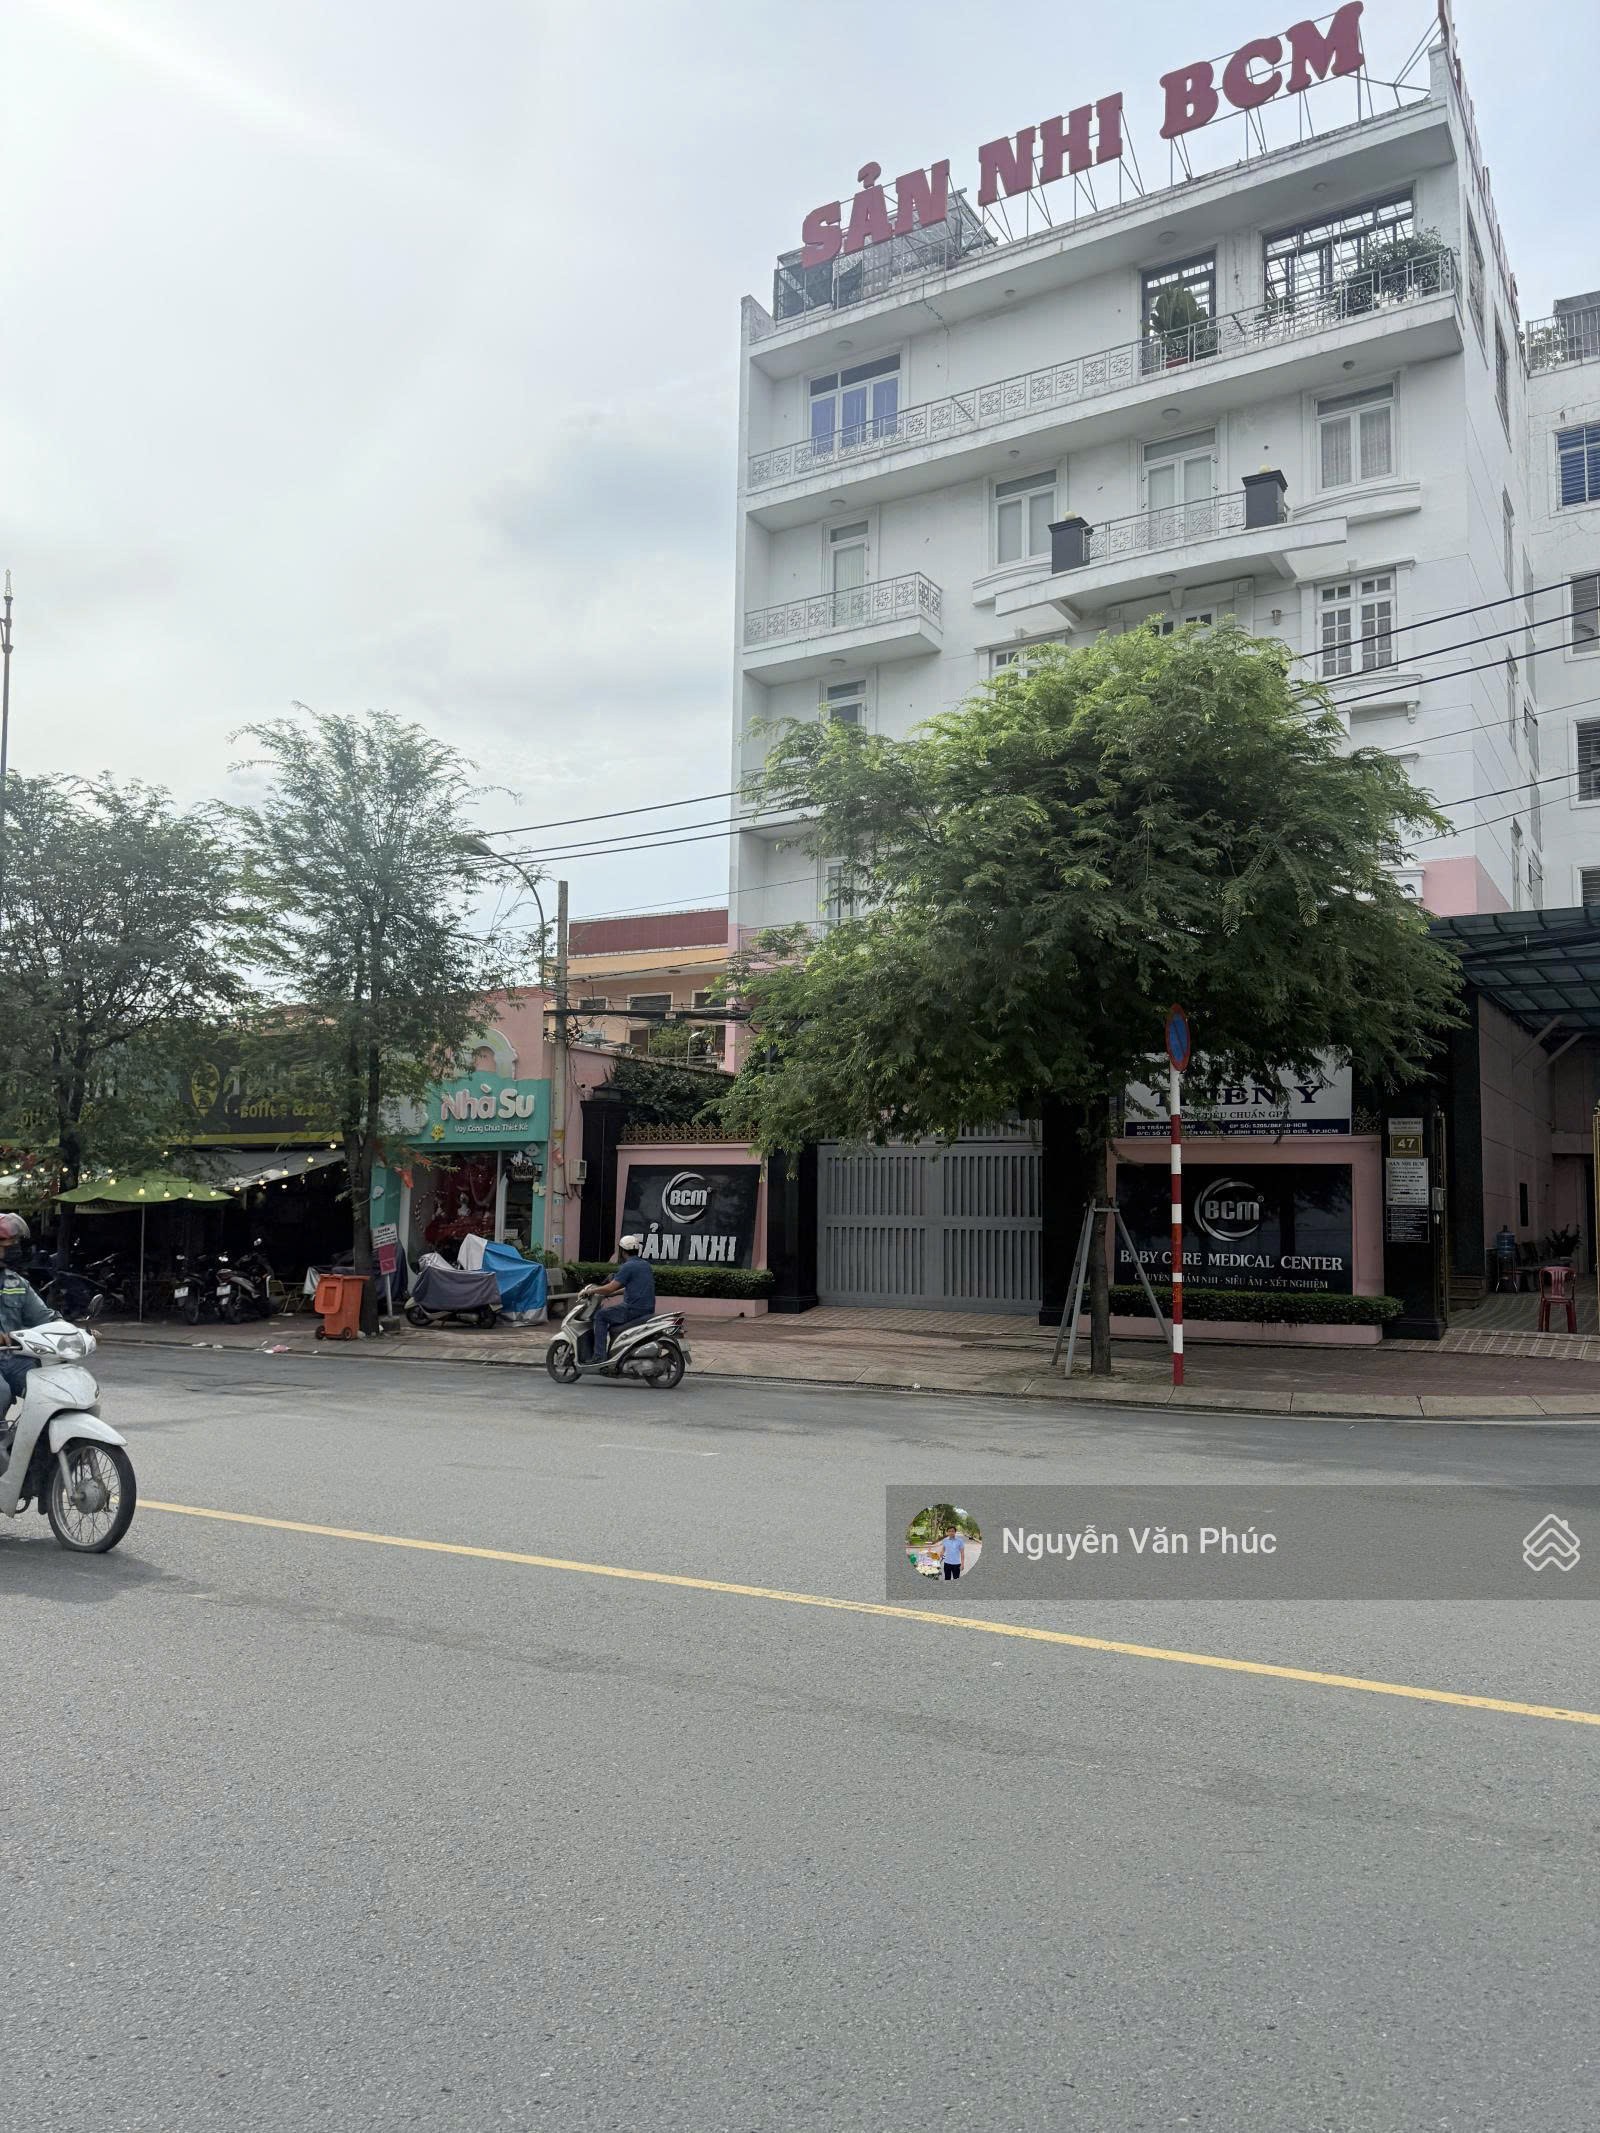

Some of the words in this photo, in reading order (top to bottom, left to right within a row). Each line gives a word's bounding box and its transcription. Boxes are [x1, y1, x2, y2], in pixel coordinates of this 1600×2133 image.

[802, 160, 950, 268] SẢN
[978, 92, 1123, 206] NHI
[1160, 1, 1365, 139] BCM
[440, 1083, 497, 1121] Nhà
[498, 1088, 535, 1119] Su
[1397, 1138, 1416, 1149] 47
[688, 1234, 737, 1262] NHI
[1161, 1251, 1203, 1266] CRE
[1207, 1253, 1275, 1269] MEDICAL
[1280, 1255, 1344, 1271] CENTER
